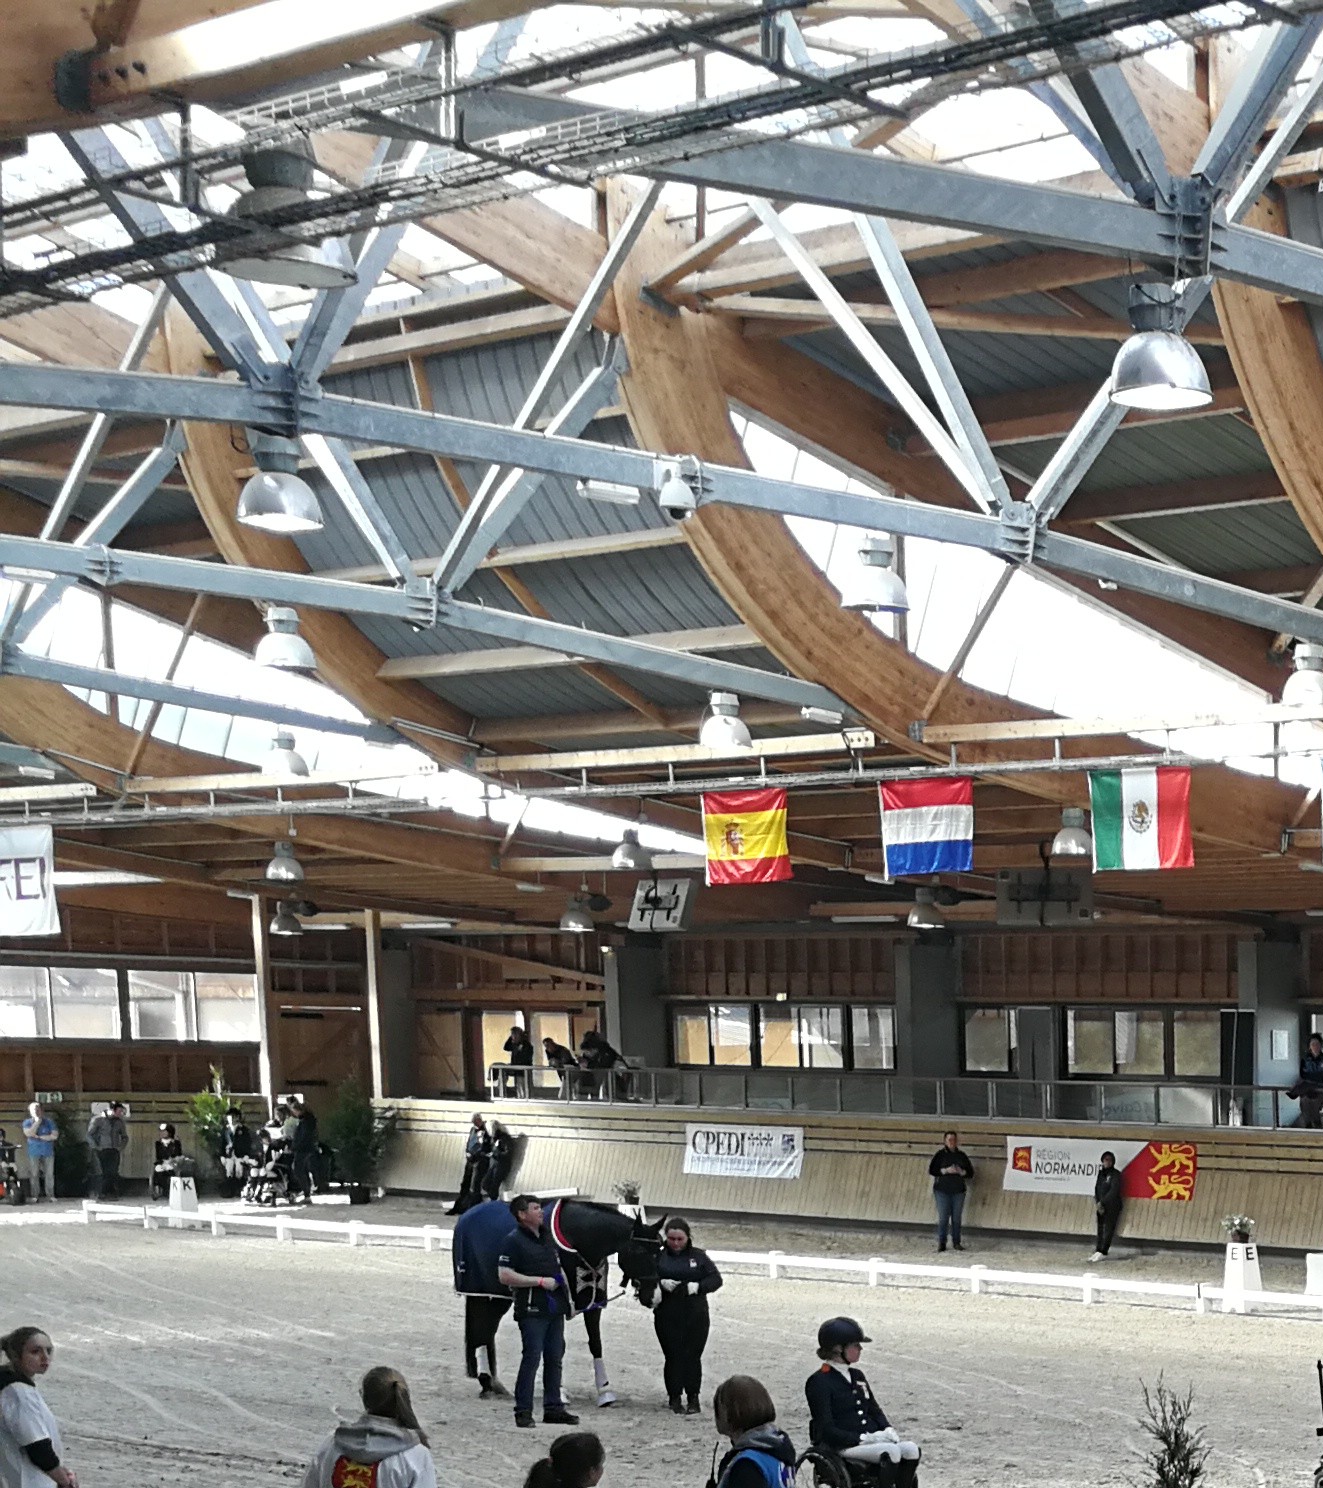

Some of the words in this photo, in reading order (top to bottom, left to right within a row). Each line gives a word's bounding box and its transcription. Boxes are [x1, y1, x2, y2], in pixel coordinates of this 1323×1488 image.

[692, 1130, 746, 1156] CPEDI
[183, 1180, 192, 1191] K
[1231, 1247, 1238, 1260] E
[1246, 1246, 1255, 1260] E
